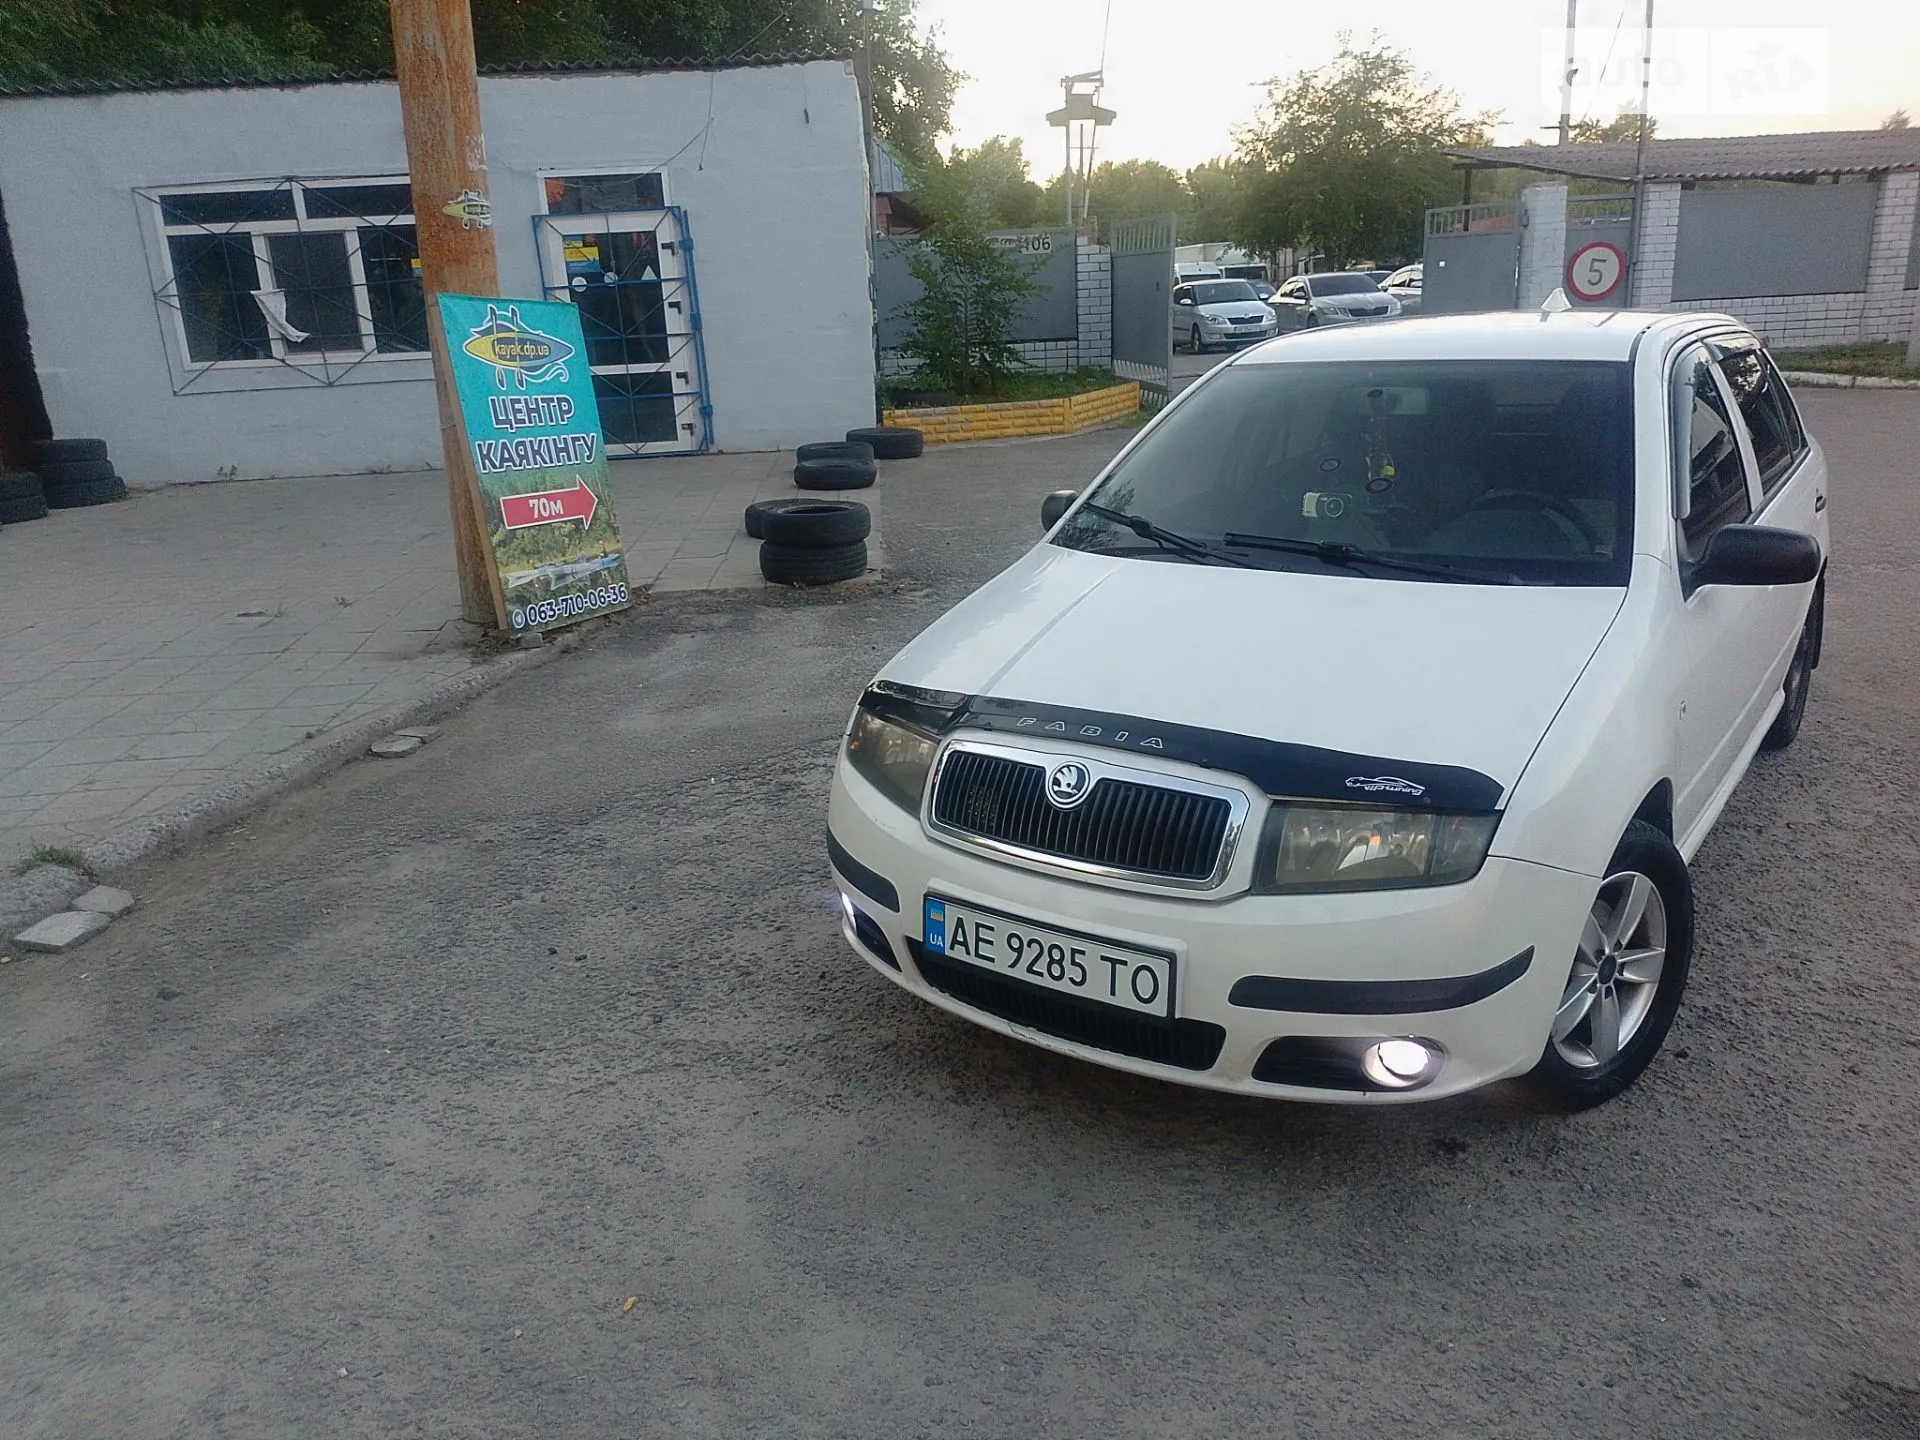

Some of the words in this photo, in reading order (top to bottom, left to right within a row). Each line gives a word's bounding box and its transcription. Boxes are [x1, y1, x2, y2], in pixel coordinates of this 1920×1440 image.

[1587, 257, 1607, 287] 5
[494, 341, 549, 359] kayak.dp.ua
[489, 395, 575, 432] ЦЕНТР
[476, 432, 598, 473] КАЯКІНГУ
[527, 582, 628, 625] 063-710-06-36
[1016, 717, 1164, 749] FABIA
[929, 933, 944, 948] UA
[948, 915, 996, 964] AE
[1006, 931, 1088, 987] 9285
[1100, 954, 1161, 1006] TO
